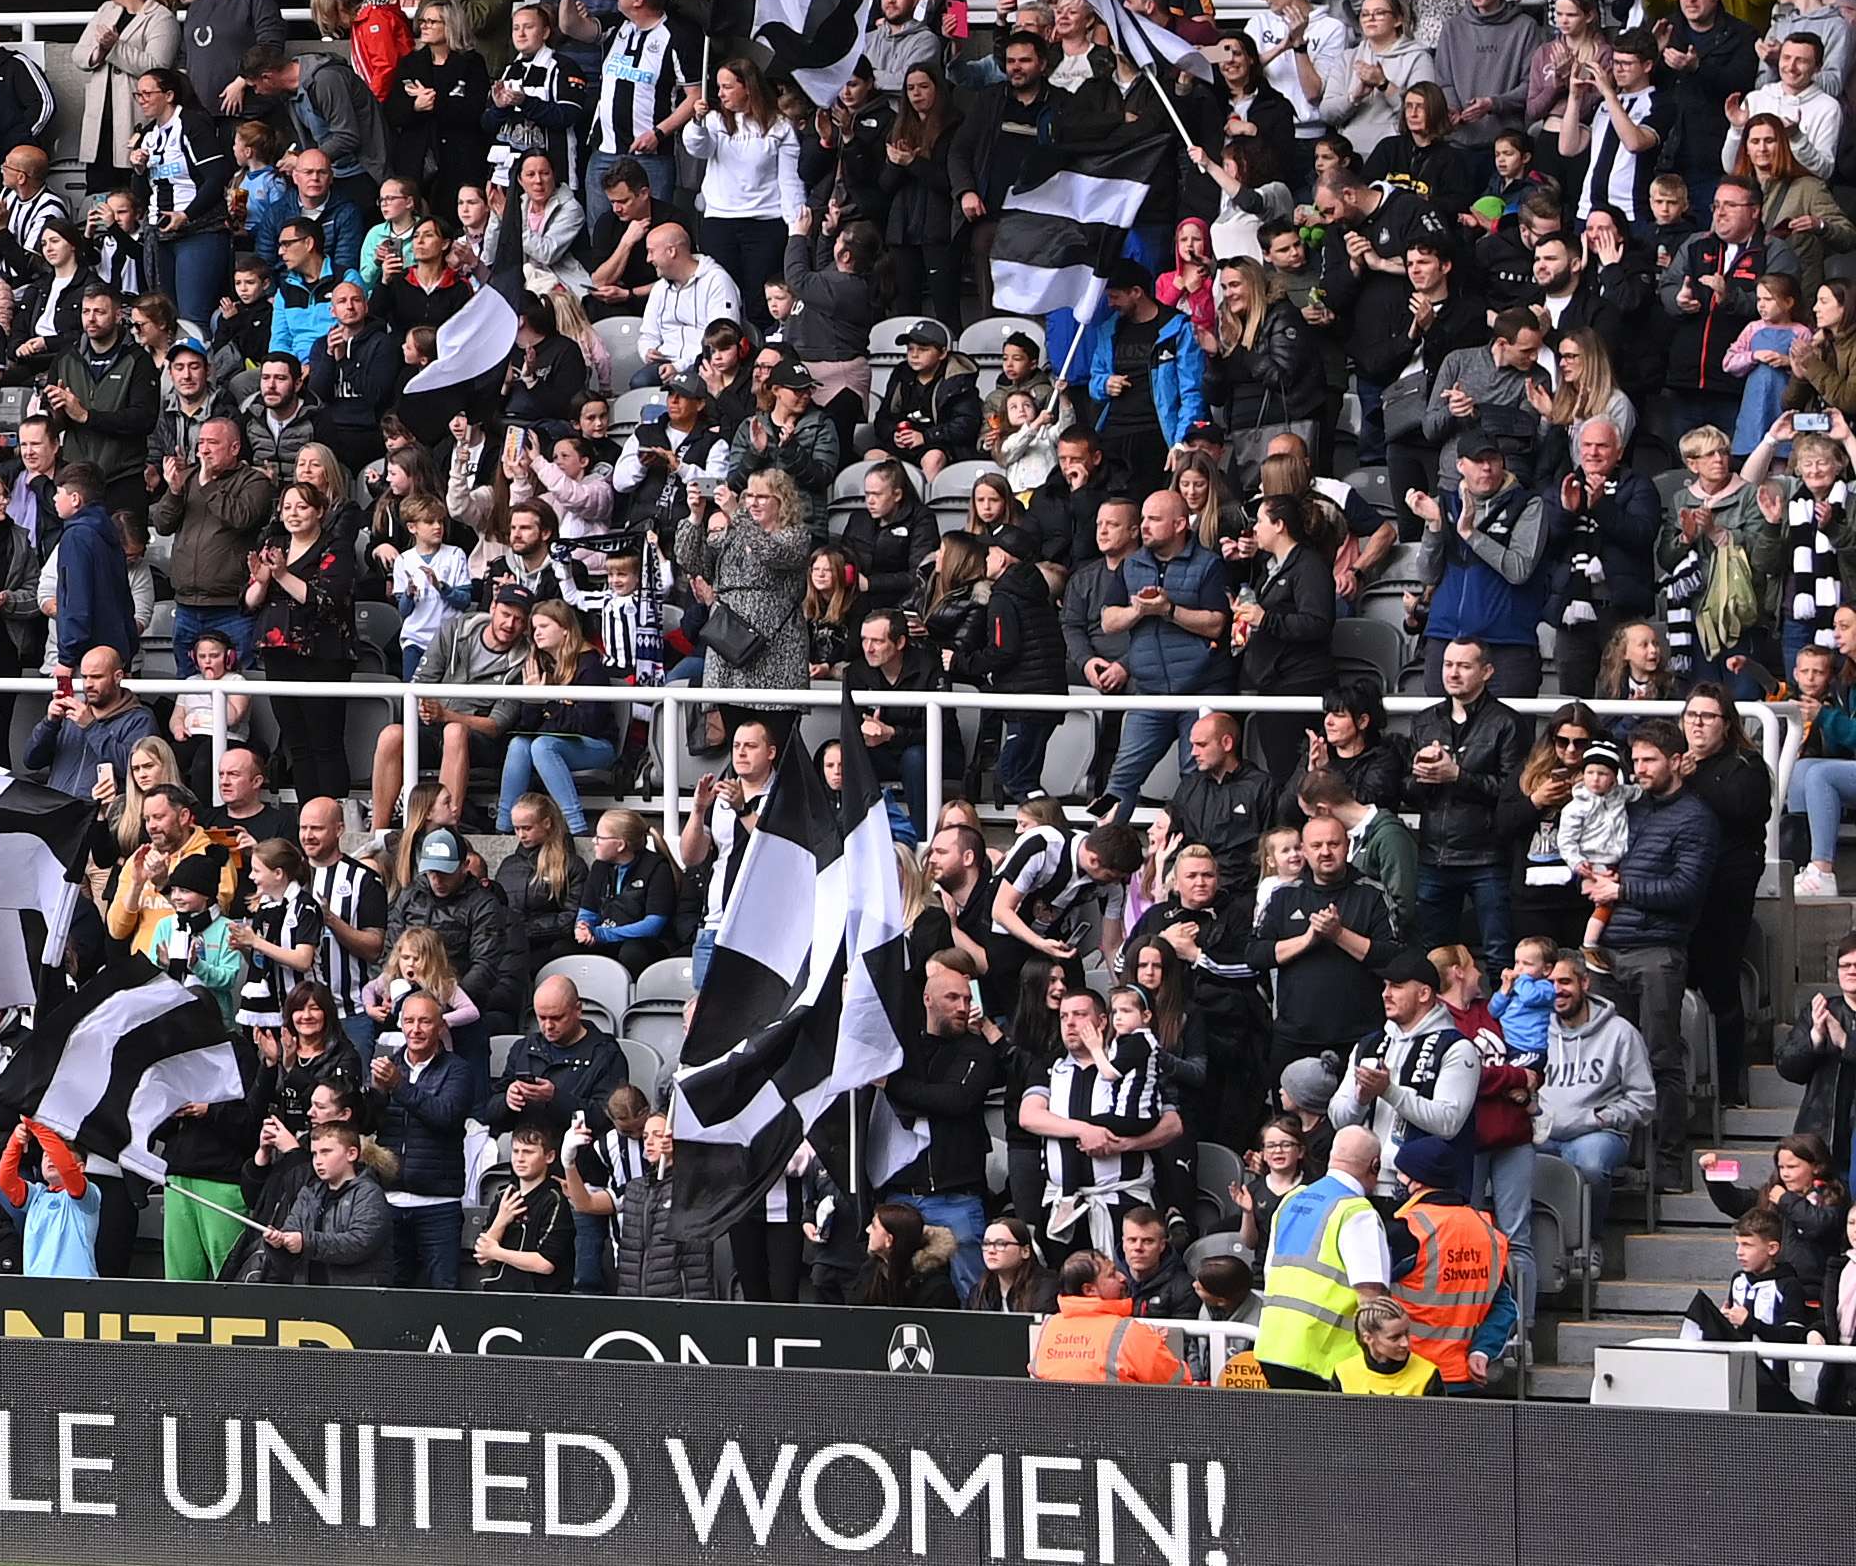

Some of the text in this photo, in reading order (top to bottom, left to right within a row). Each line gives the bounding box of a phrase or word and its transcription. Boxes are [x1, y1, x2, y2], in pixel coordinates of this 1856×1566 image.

[1447, 1247, 1481, 1265] Safety
[1054, 1333, 1092, 1347] Safety
[1046, 1347, 1096, 1361] Steward
[162, 1413, 630, 1536] UNITED
[664, 1436, 1227, 1566] WOMEN!
